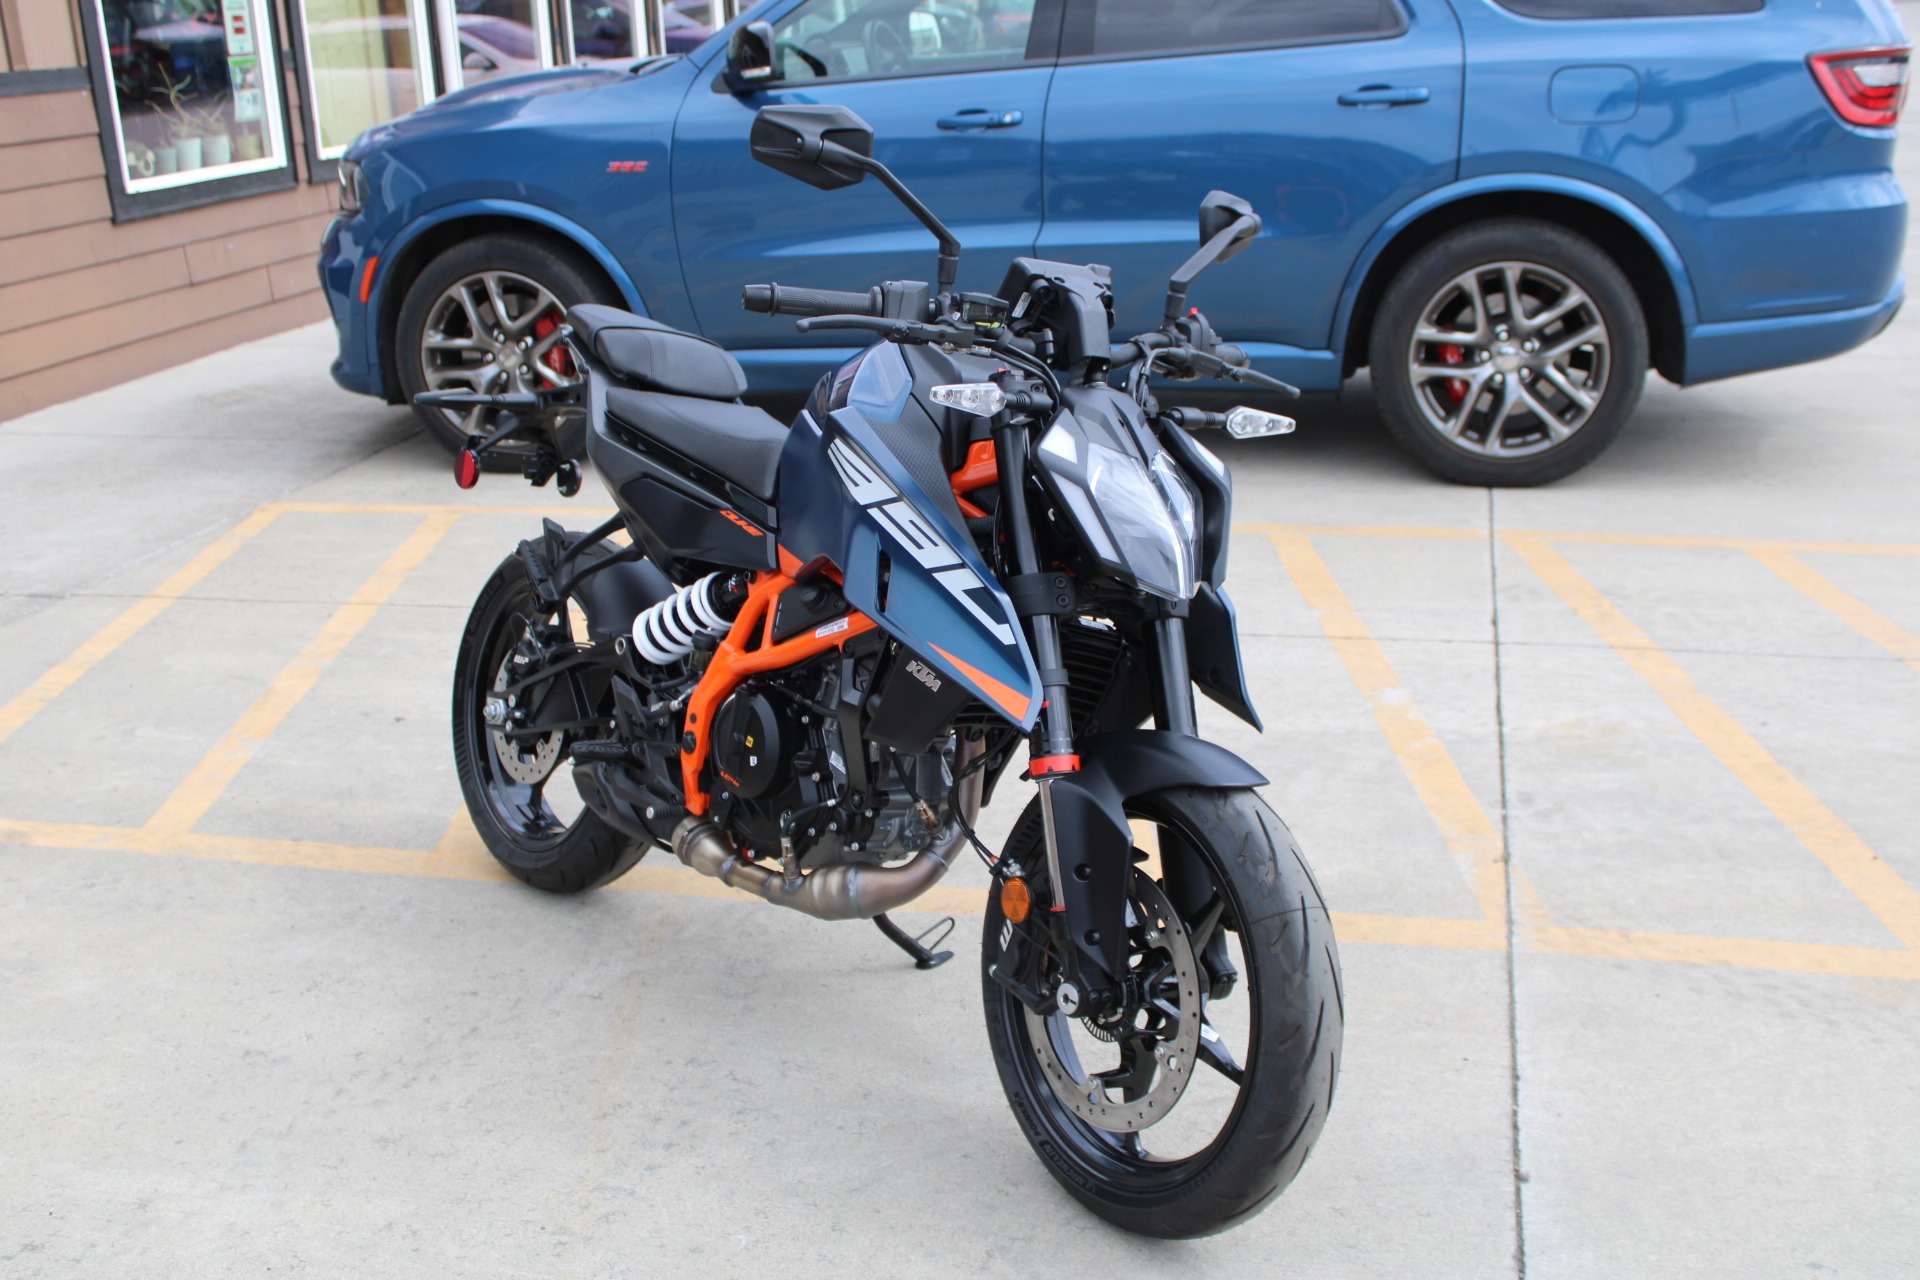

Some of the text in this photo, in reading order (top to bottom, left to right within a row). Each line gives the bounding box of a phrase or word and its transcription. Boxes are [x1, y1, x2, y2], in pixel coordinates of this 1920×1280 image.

[606, 160, 648, 172] 392
[719, 510, 764, 536] DUKE
[905, 659, 941, 692] KTM
[1042, 1144, 1086, 1186] MICHELIN
